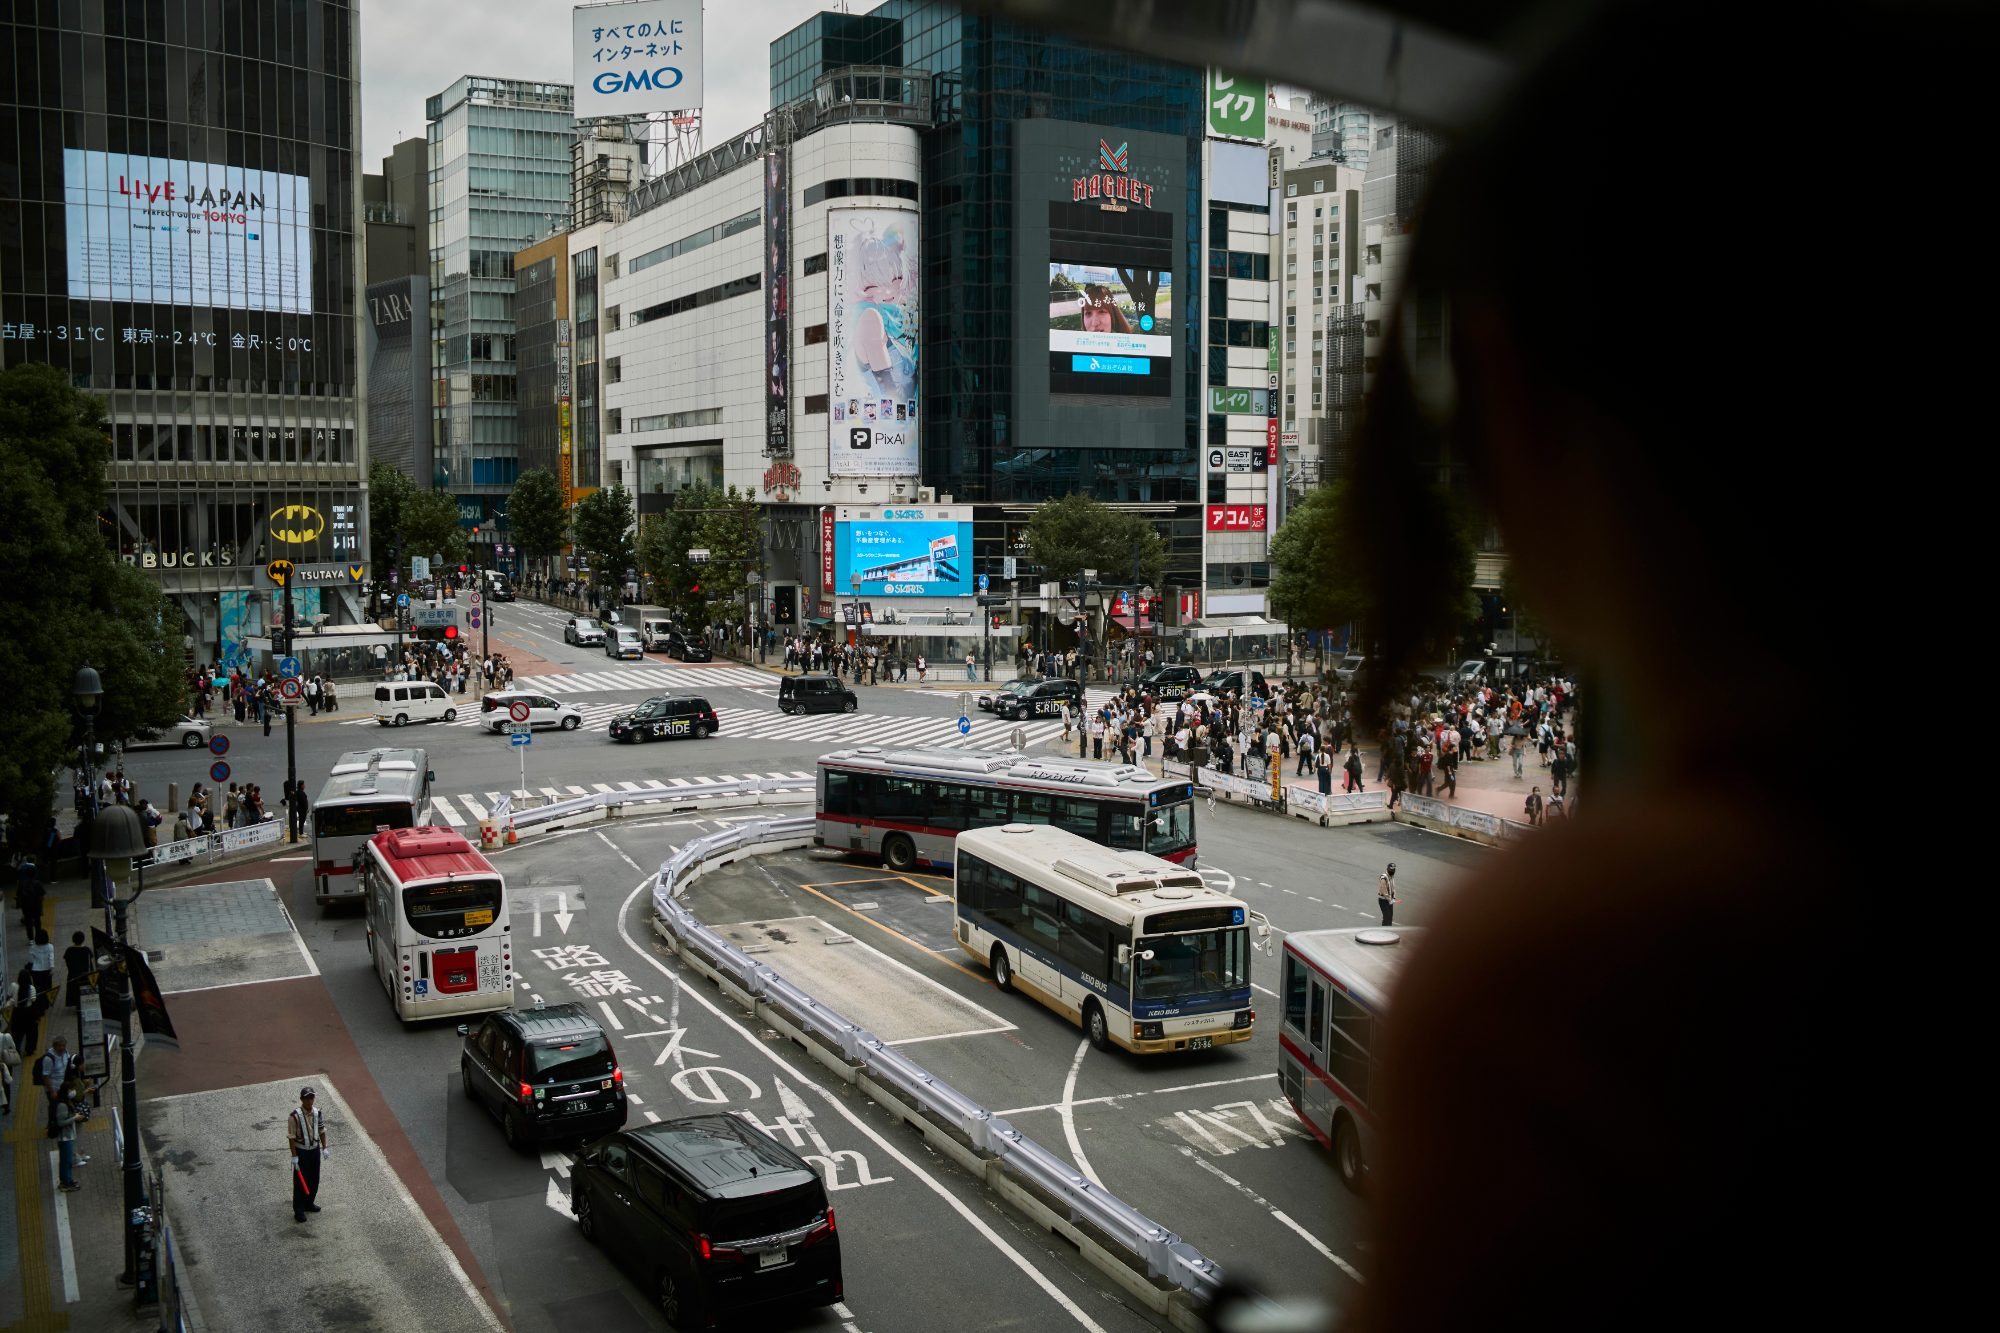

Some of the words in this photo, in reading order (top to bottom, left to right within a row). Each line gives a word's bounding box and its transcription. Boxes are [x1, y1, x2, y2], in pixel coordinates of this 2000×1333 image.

[592, 20, 683, 43] すべての人に
[592, 40, 683, 63] インターネット
[592, 66, 683, 95] GMO
[119, 175, 175, 203] LIVE
[184, 184, 266, 213] JAPAN
[1073, 174, 1154, 208] MAGNET
[202, 210, 247, 225] TOKYO
[371, 292, 412, 326] ZARA
[1214, 391, 1249, 408] レイク
[1254, 402, 1264, 413] 5F
[875, 432, 905, 445] PixAI
[1227, 450, 1250, 458] EAST
[1253, 456, 1263, 467] 4F
[763, 463, 800, 493] MAGNET
[894, 509, 925, 519] STARTS
[1212, 510, 1250, 525] アコム
[1253, 507, 1264, 516] 3F
[300, 569, 345, 580] TSUTAYA
[894, 584, 925, 594] STARTS
[418, 610, 454, 619] 渋谷駅前
[653, 723, 690, 736] S.RIDE
[1081, 971, 1096, 985] KEIO
[1094, 978, 1108, 993] BUS
[1148, 1009, 1165, 1017] KEIO
